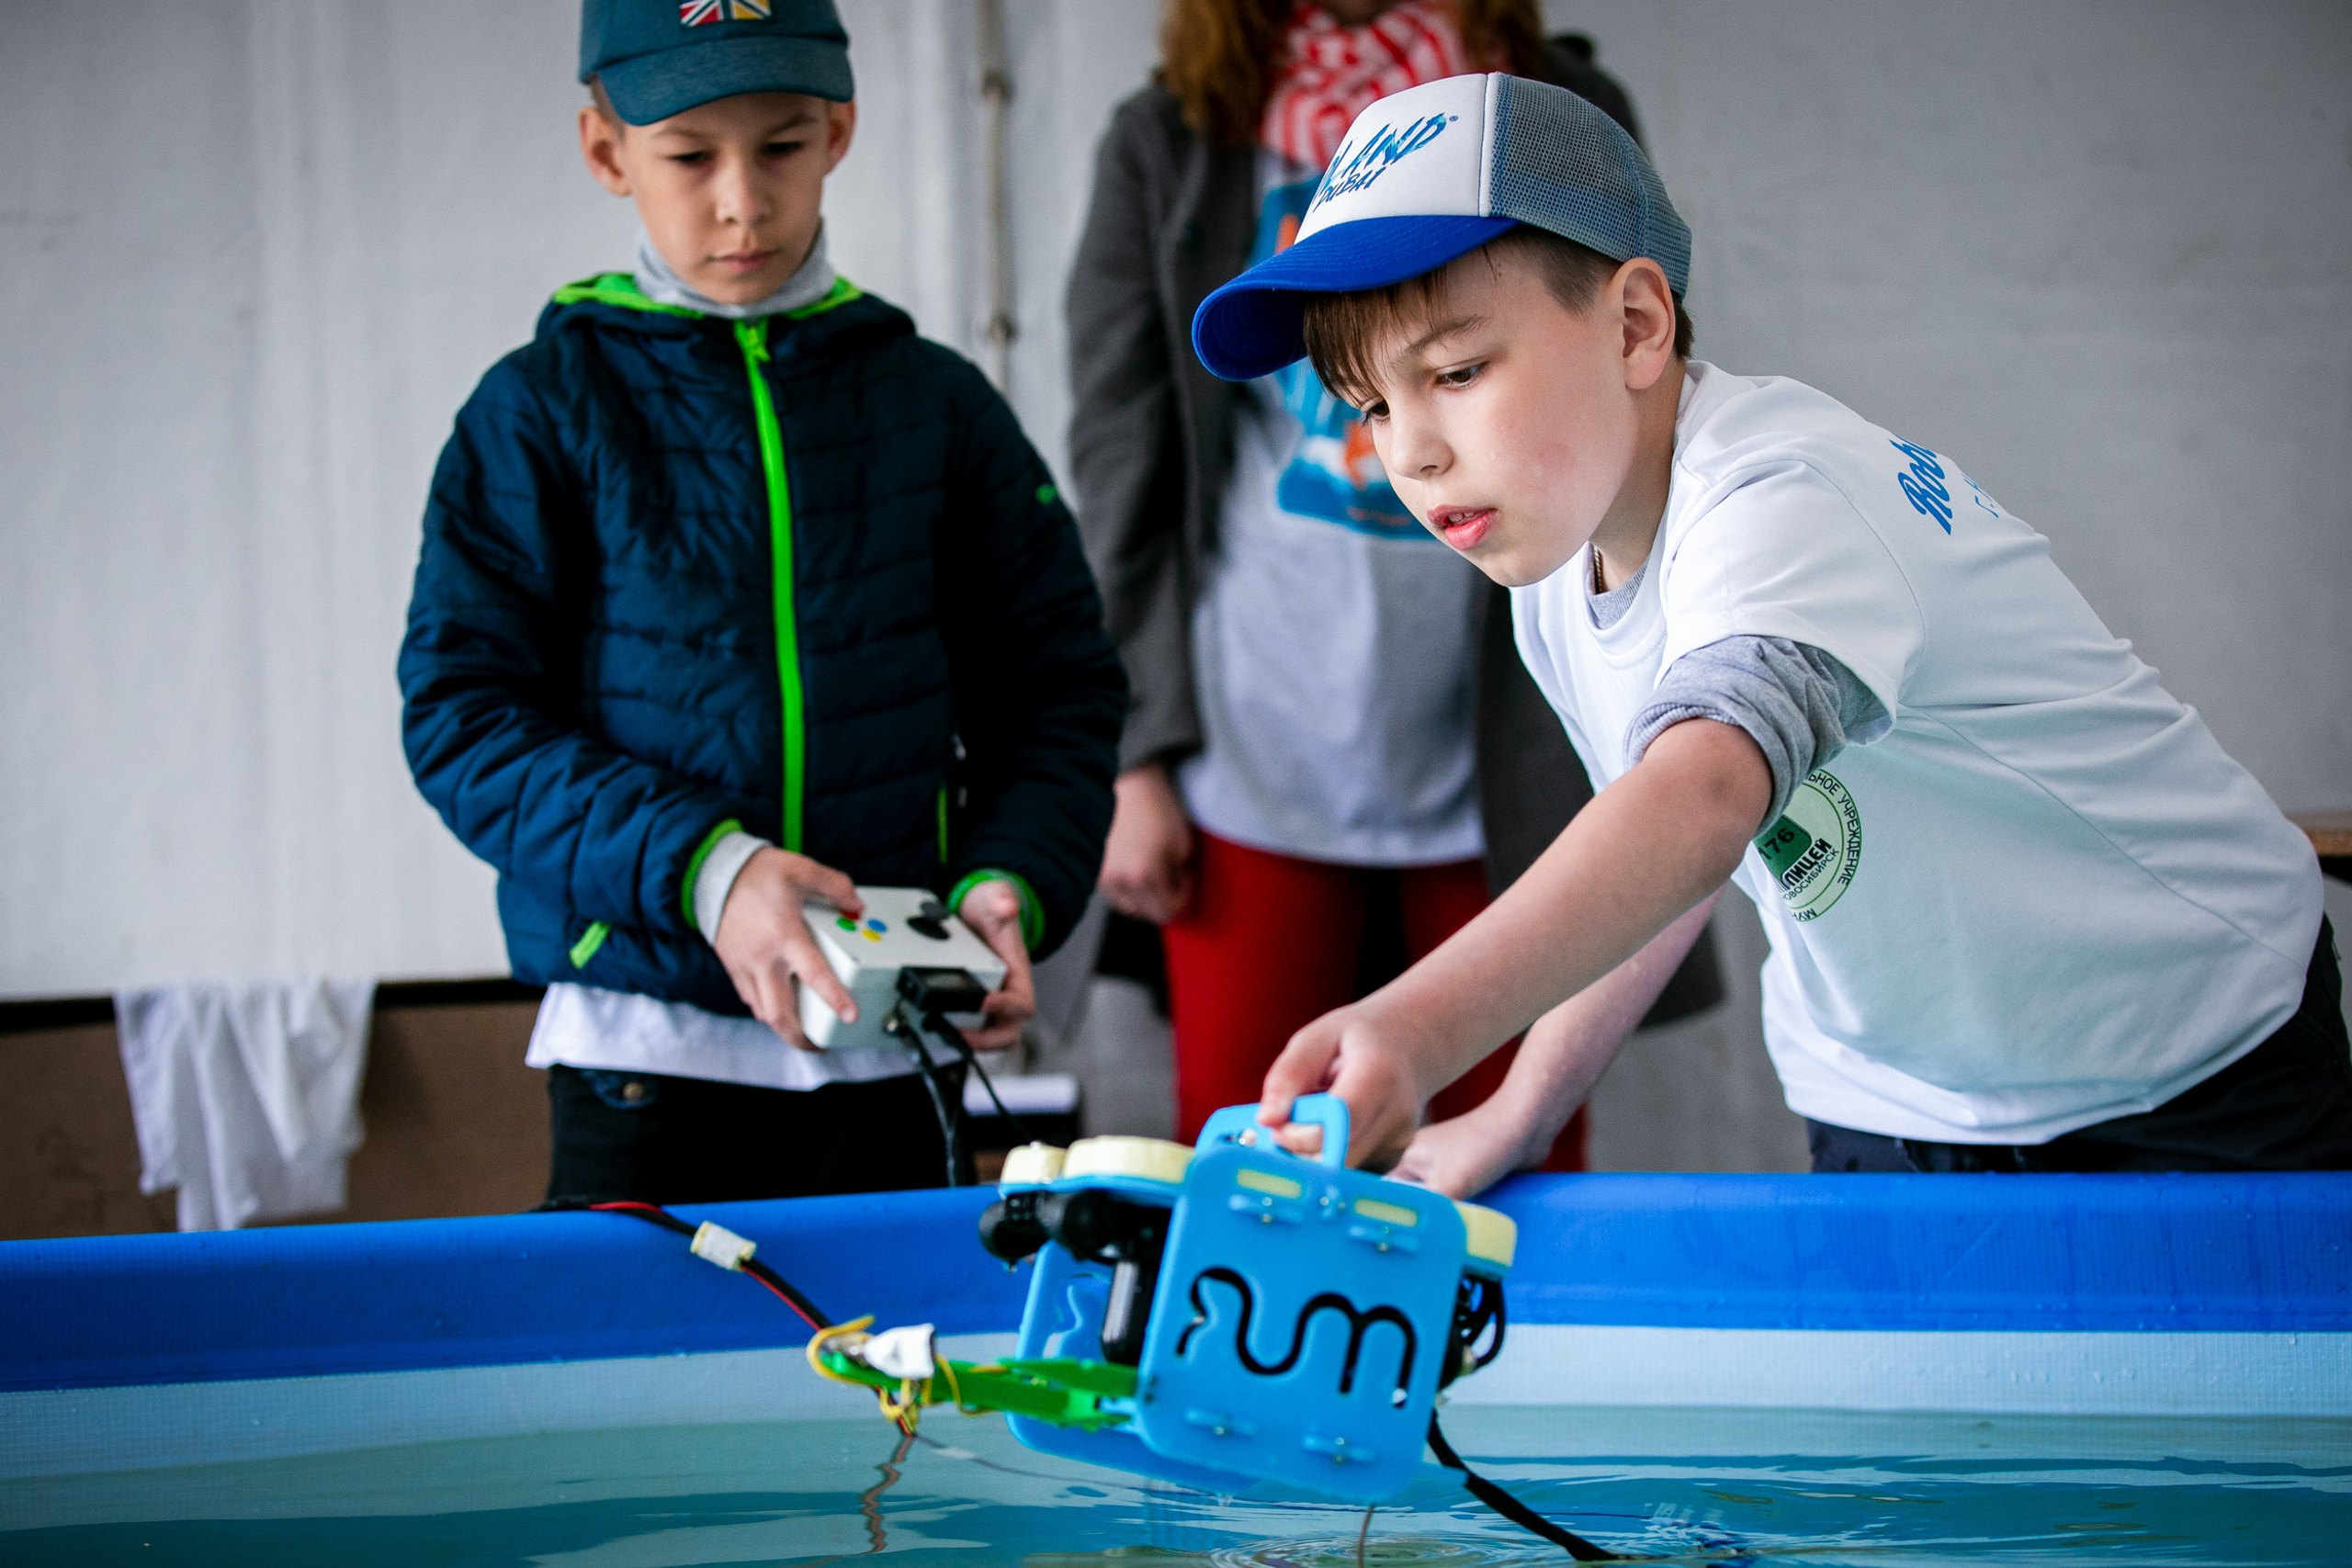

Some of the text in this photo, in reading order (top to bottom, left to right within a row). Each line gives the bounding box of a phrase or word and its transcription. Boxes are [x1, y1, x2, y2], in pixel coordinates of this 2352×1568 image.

[1312, 166, 1386, 213] DUBAI
[1806, 773, 1859, 886] ЬНОЕ УЧРЕЖДЕНИЕ
[1781, 838, 1832, 890] ЛИЦЕЙ
[1783, 848, 1839, 900] ОВОСИБИРСК
